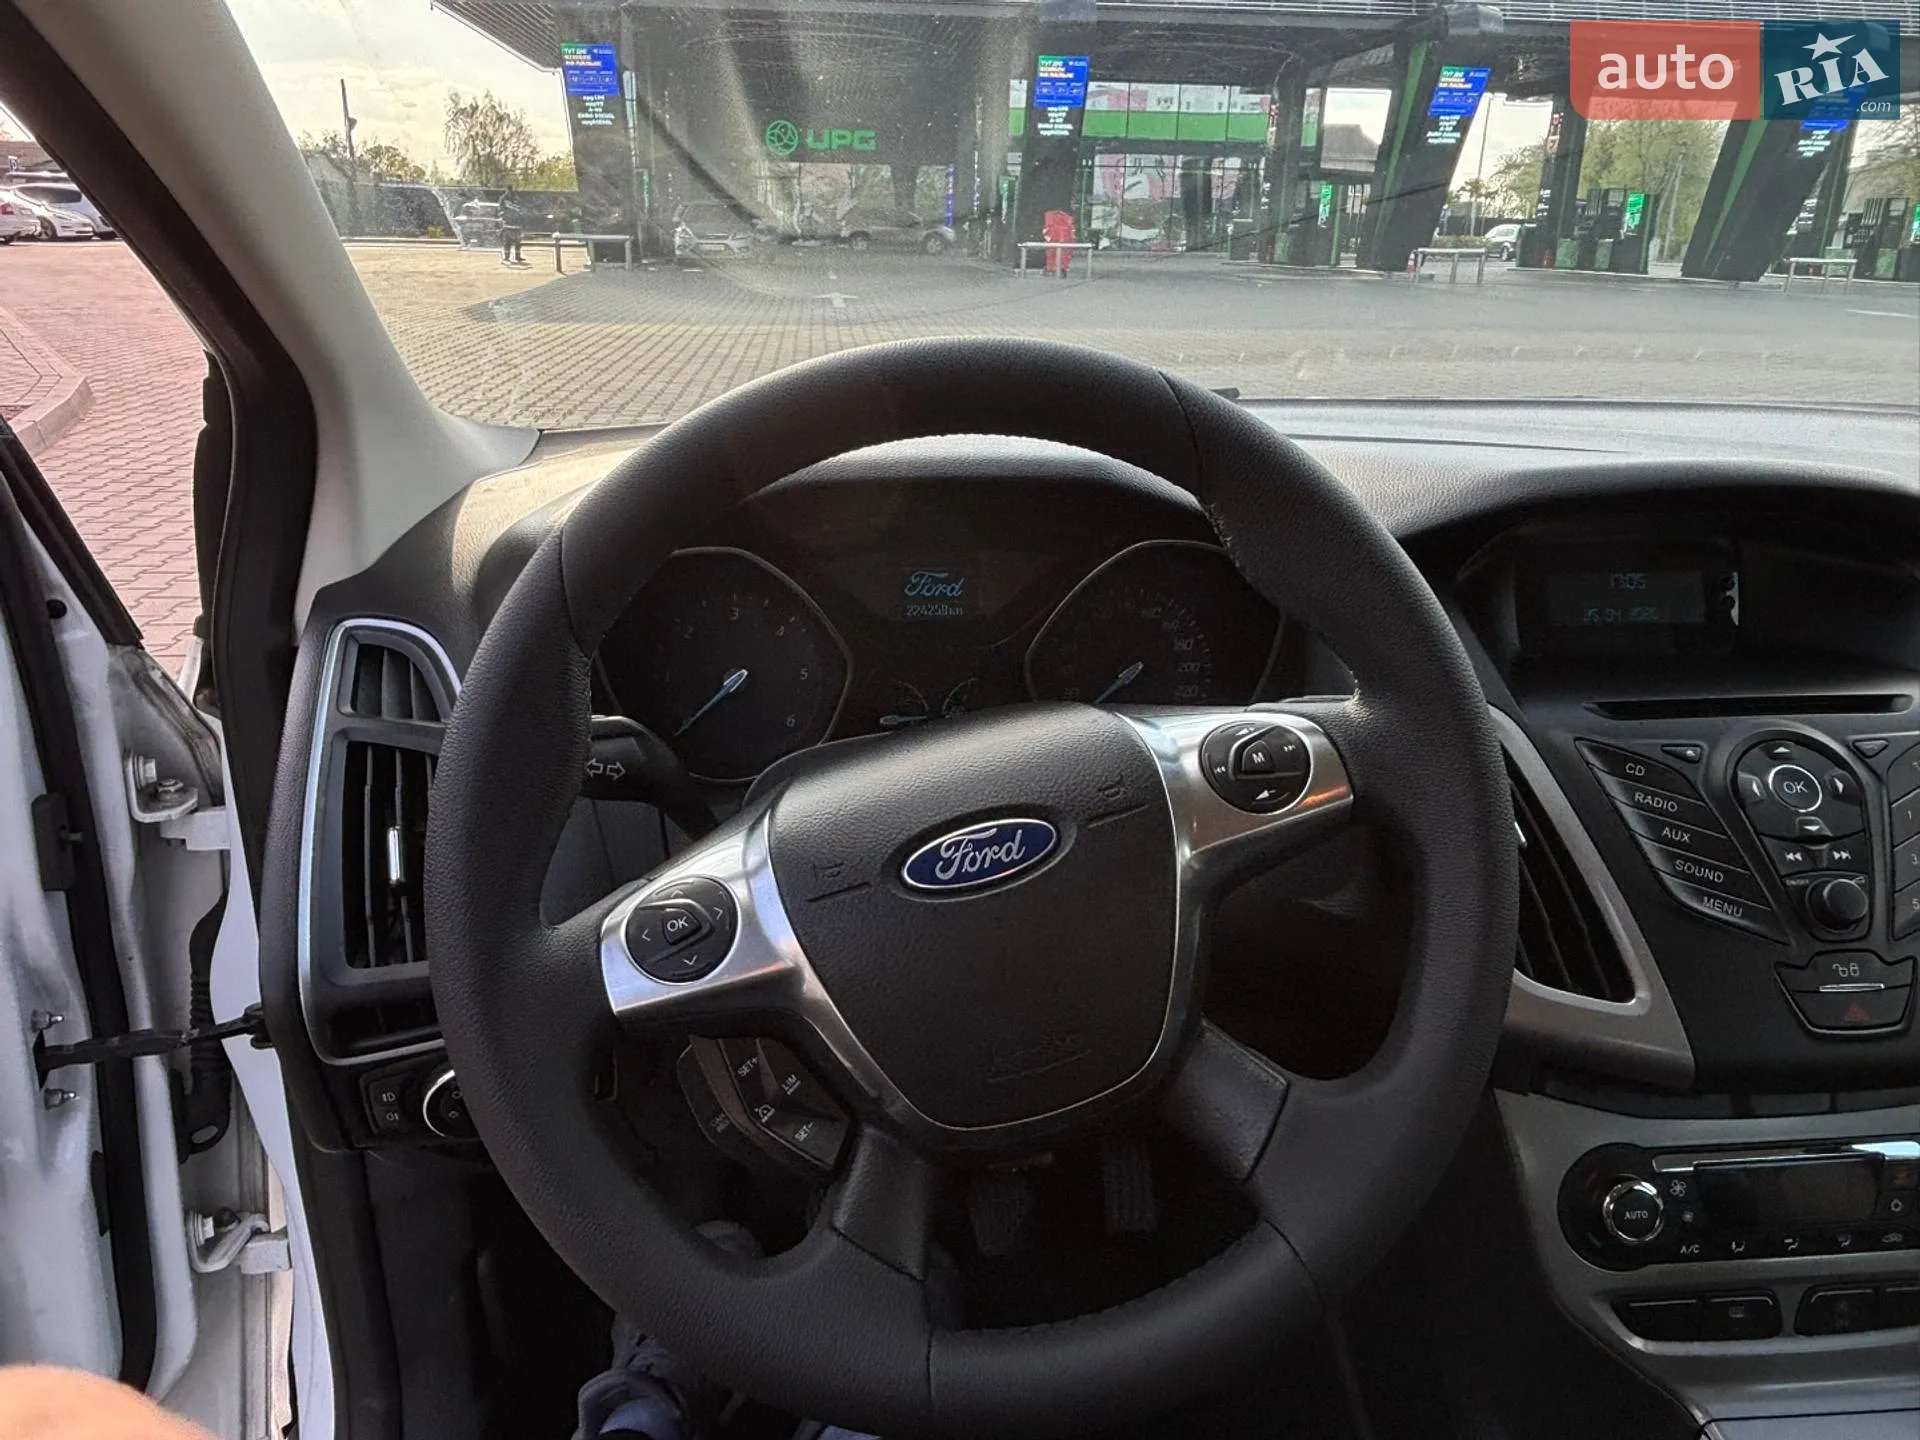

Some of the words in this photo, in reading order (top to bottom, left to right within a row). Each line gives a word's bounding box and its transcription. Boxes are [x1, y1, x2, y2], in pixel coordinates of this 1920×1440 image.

[807, 128, 876, 150] UPG
[904, 571, 964, 596] Ford
[800, 668, 808, 681] 5
[786, 714, 796, 727] 6
[1252, 752, 1265, 764] M
[1625, 763, 1646, 777] CD
[1783, 780, 1806, 795] OK
[1634, 791, 1678, 813] RADIO
[1661, 826, 1691, 844] AUX
[935, 828, 1026, 880] Ford
[1675, 859, 1724, 883] SOUND
[1702, 895, 1743, 918] MENU
[667, 916, 688, 932] OK
[1624, 1209, 1649, 1220] AUTO
[1680, 1244, 1700, 1255] A/C
